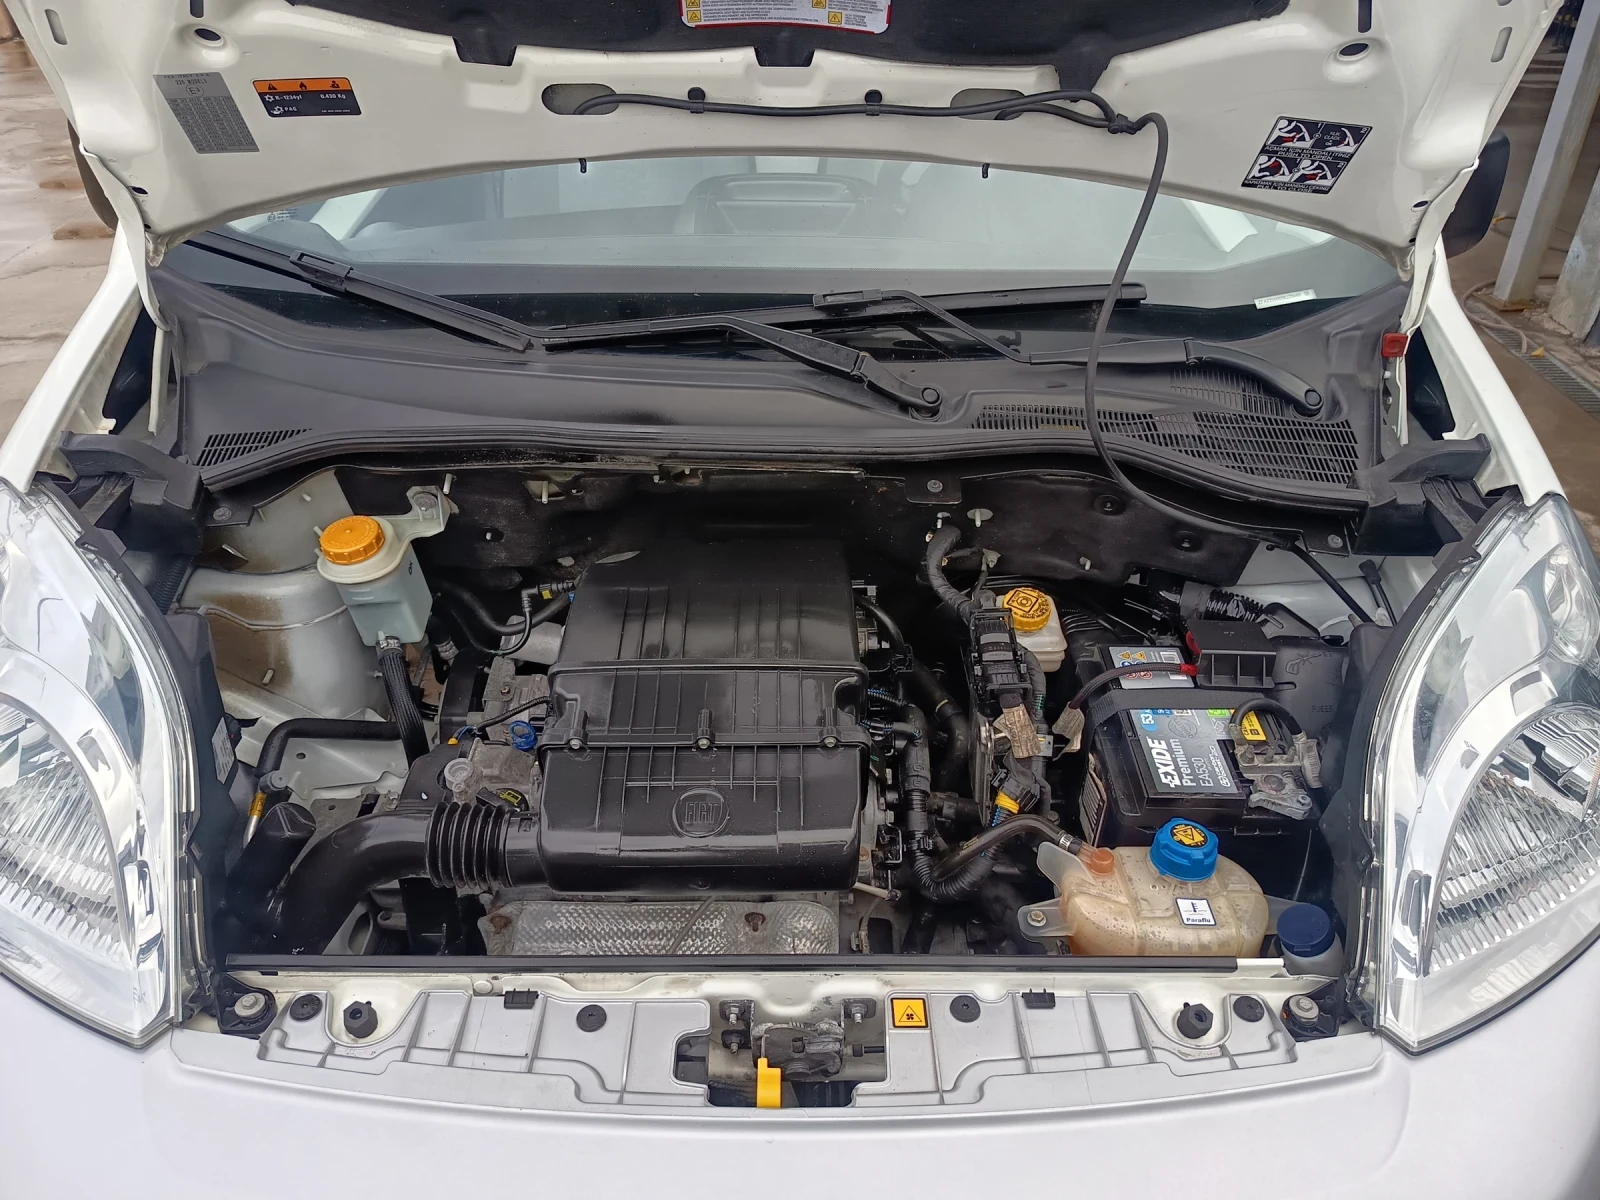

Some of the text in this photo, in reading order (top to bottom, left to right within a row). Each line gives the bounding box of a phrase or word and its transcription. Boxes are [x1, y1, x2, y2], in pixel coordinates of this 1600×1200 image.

[1141, 714, 1154, 724] 53
[1147, 737, 1182, 788] EXIDE
[1170, 738, 1196, 787] Premium
[1192, 757, 1214, 787] EA530
[685, 802, 718, 824] FIAT
